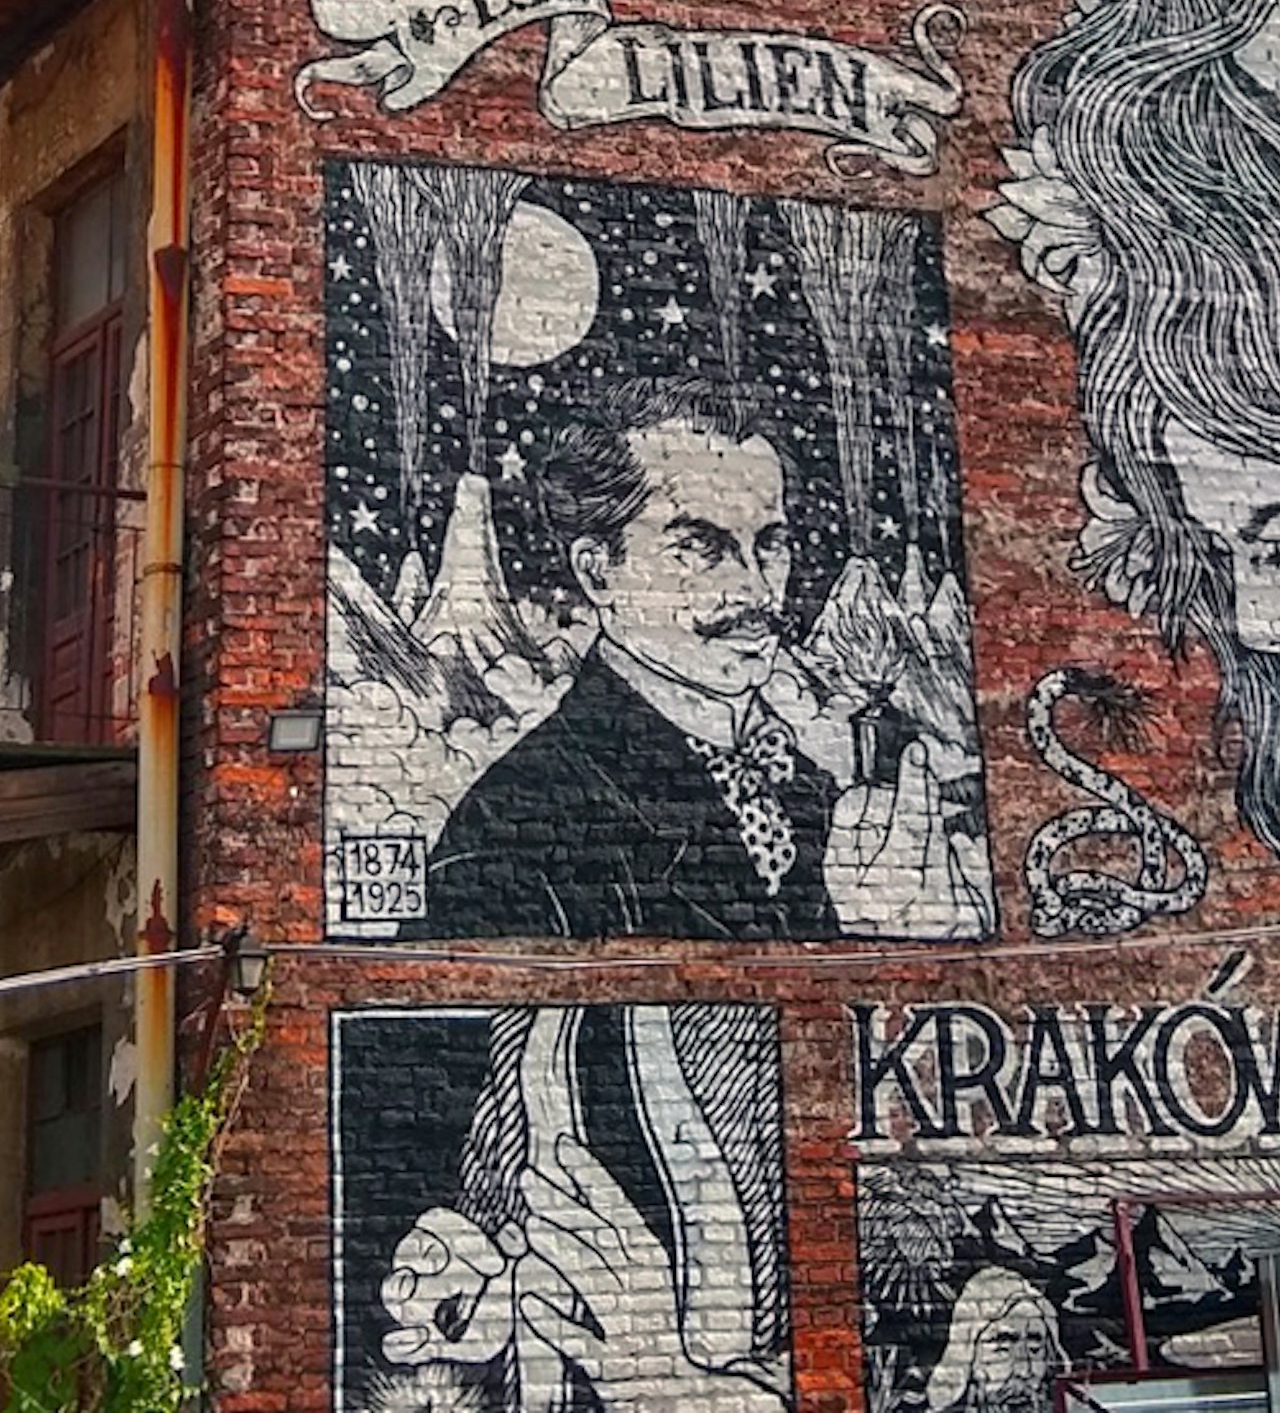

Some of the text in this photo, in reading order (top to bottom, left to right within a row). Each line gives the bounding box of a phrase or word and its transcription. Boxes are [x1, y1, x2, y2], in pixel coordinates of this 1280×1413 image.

[622, 35, 875, 137] LILIEN
[348, 843, 421, 878] 1874
[347, 881, 422, 914] 1925
